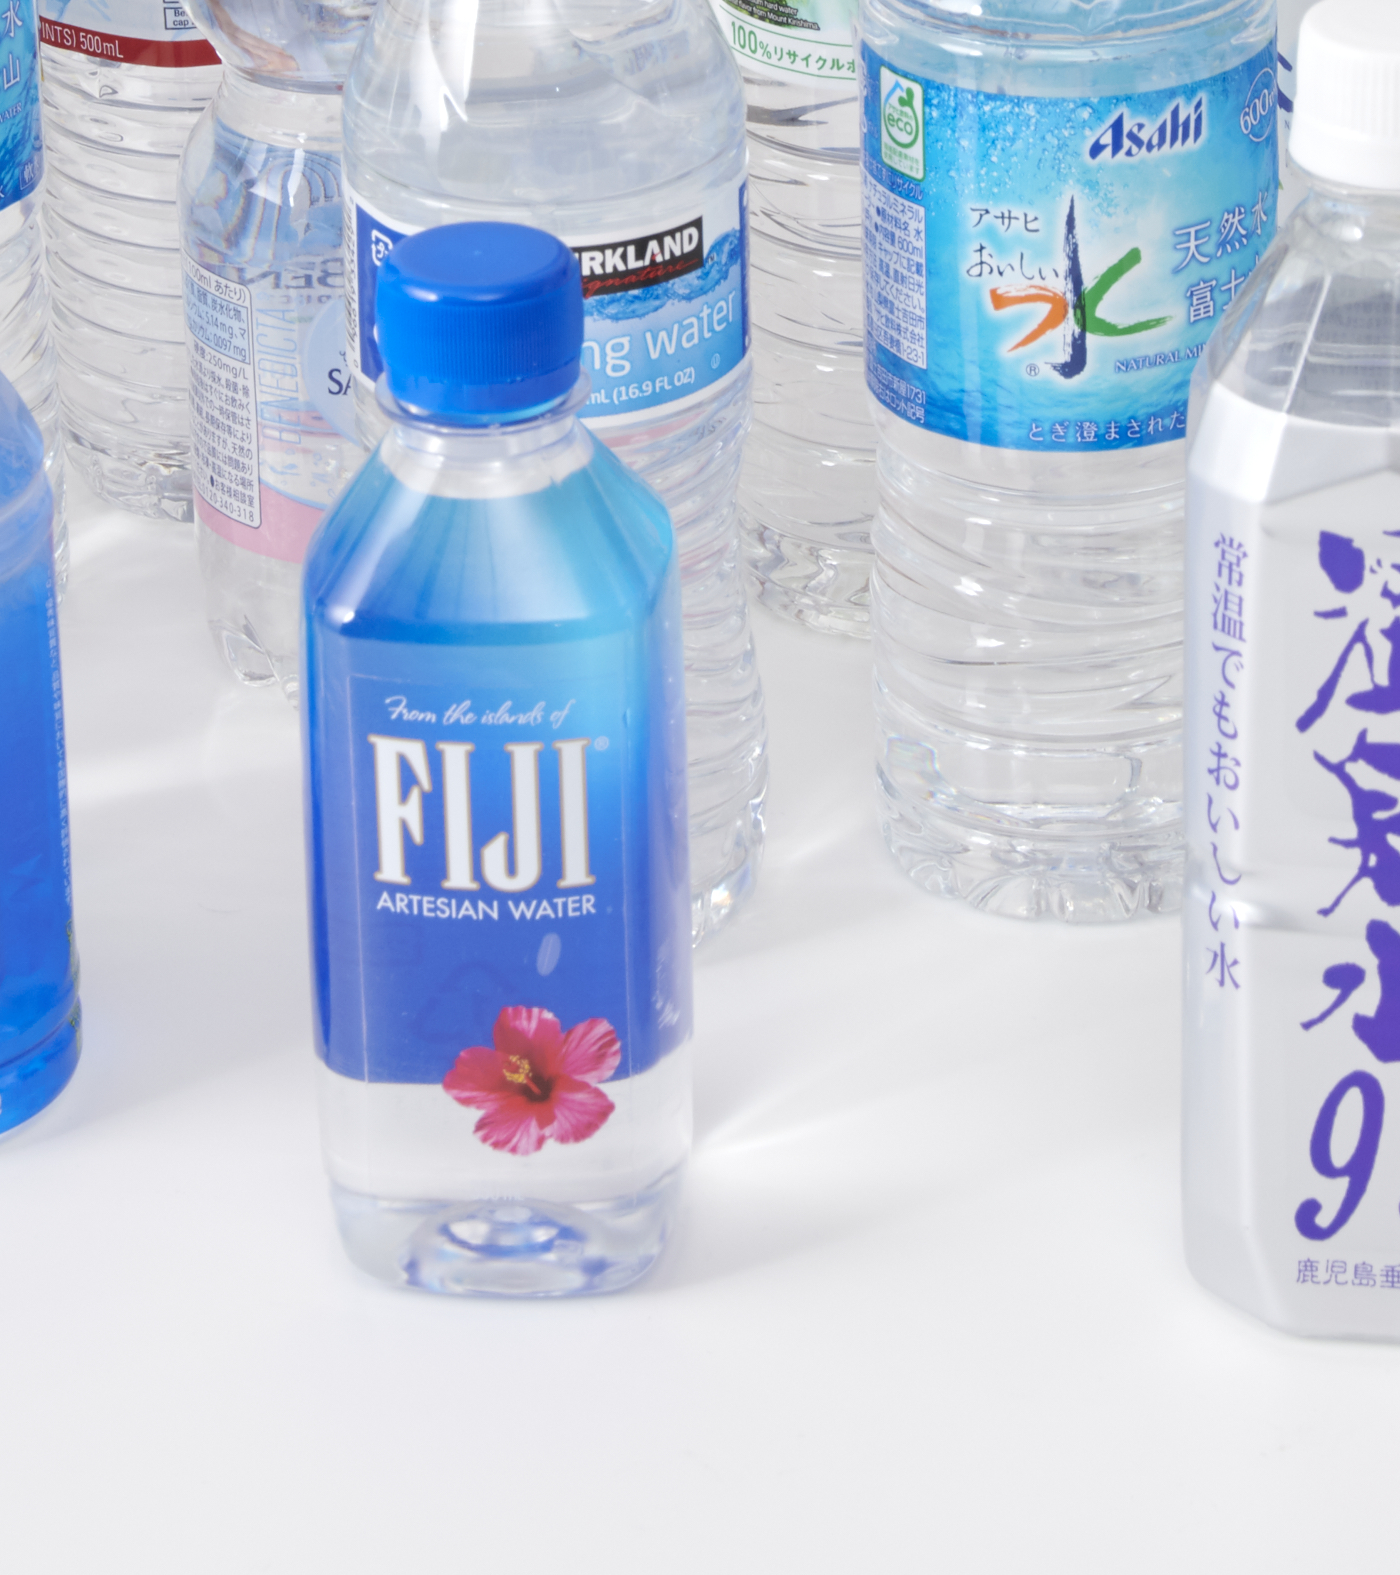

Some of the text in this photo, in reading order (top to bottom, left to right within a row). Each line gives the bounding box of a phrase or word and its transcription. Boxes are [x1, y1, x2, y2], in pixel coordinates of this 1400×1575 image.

[173, 18, 190, 28] cap
[767, 9, 788, 24] Mount
[79, 32, 125, 59] 500mL
[887, 112, 913, 137] eco
[1088, 96, 1206, 162] Asahi
[968, 206, 1041, 234] アサヒ
[1172, 191, 1269, 276] 天然水
[965, 242, 1060, 281] おいしい
[214, 278, 247, 305] あたり)
[990, 193, 1173, 379] 水
[1186, 254, 1263, 325] 富士
[646, 291, 737, 361] water
[255, 304, 302, 445] BENEDICTA
[1114, 347, 1183, 374] NATURAL
[612, 365, 696, 406] (16.9 FL OZ)
[1028, 410, 1187, 442] とぎ澄まされた
[384, 694, 577, 731] From the islands of
[1203, 531, 1248, 991] 常温でもおいしい水
[366, 733, 597, 893] FIJI
[375, 890, 597, 922] ARTESIAN WATER
